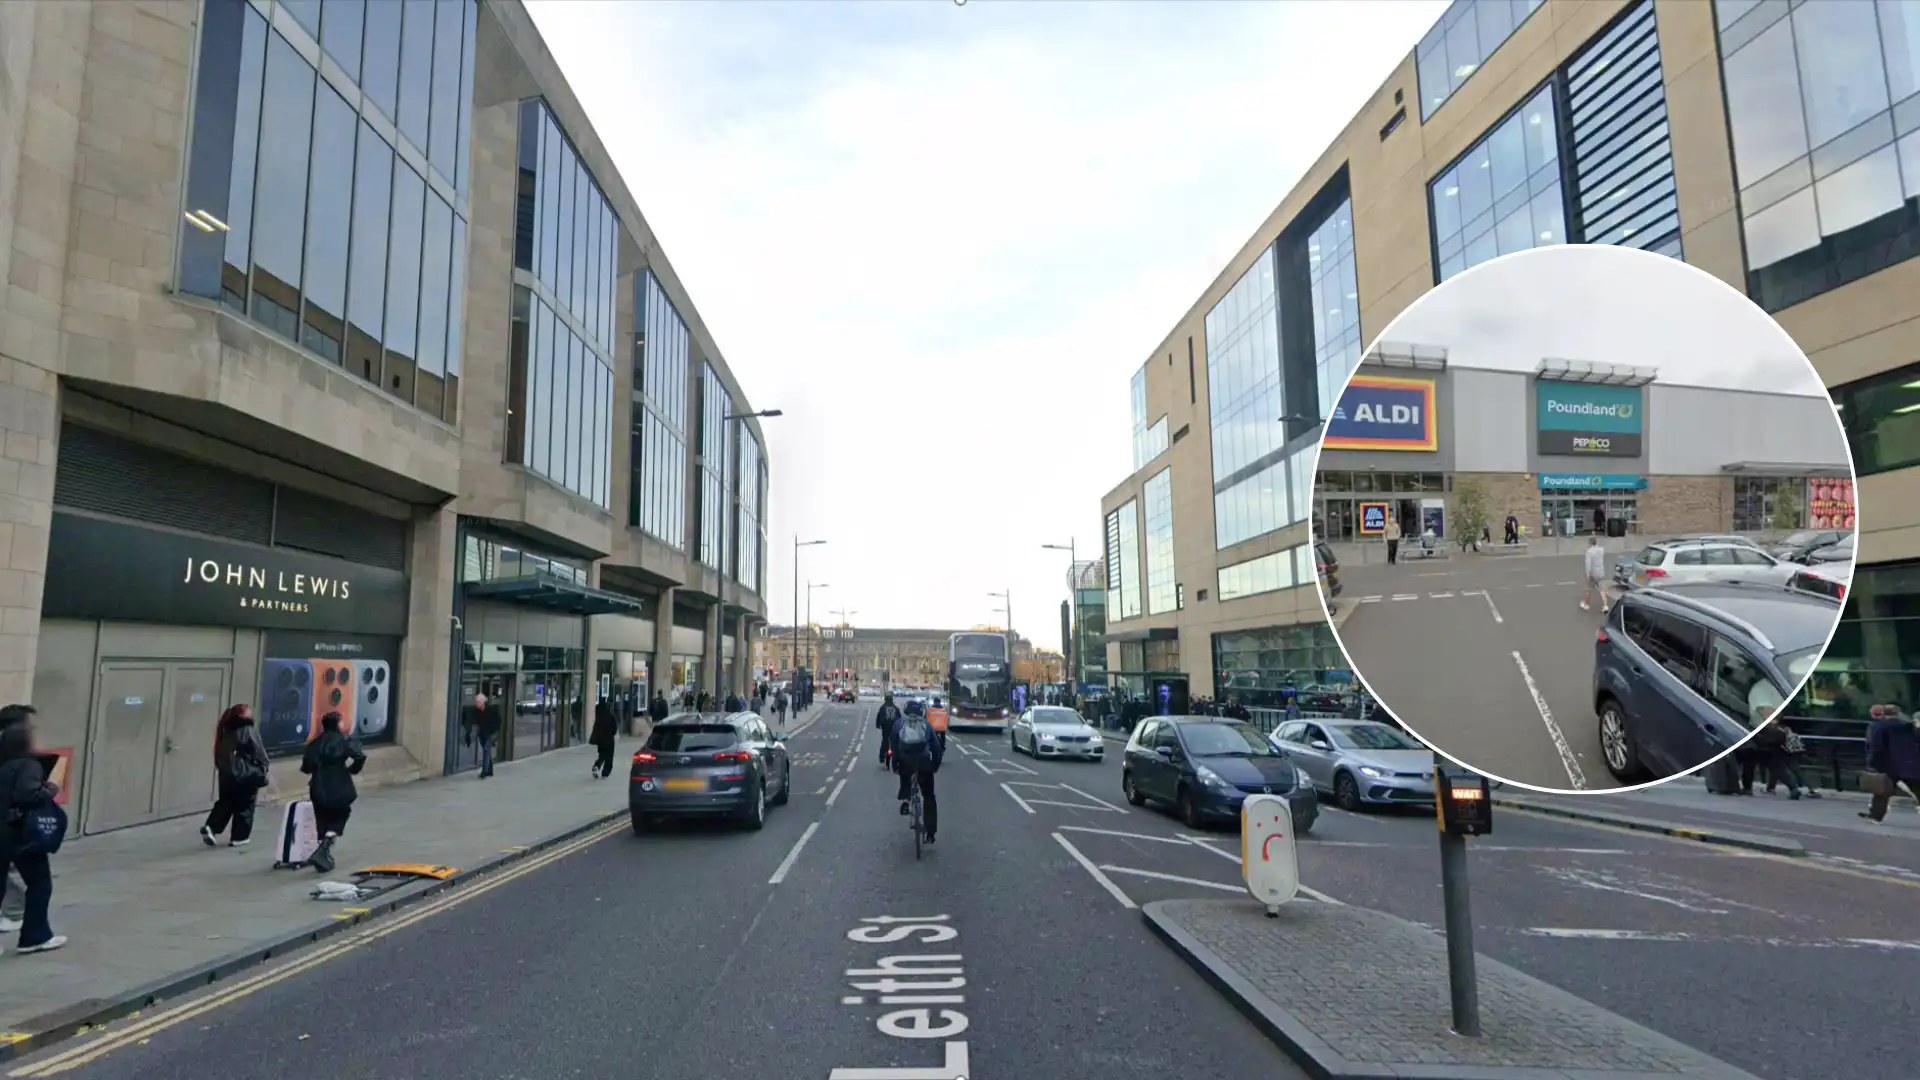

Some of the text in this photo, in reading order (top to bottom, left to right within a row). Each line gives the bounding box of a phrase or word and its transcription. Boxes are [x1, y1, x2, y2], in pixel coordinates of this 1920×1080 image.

[1353, 403, 1420, 425] ALDI
[1547, 399, 1616, 417] Poundland
[1543, 476, 1590, 485] Poundland
[1365, 520, 1385, 528] ALDI
[184, 557, 350, 600] JOHN LEWIS
[240, 597, 309, 613] & PARTNERS
[1452, 789, 1481, 799] WAIT
